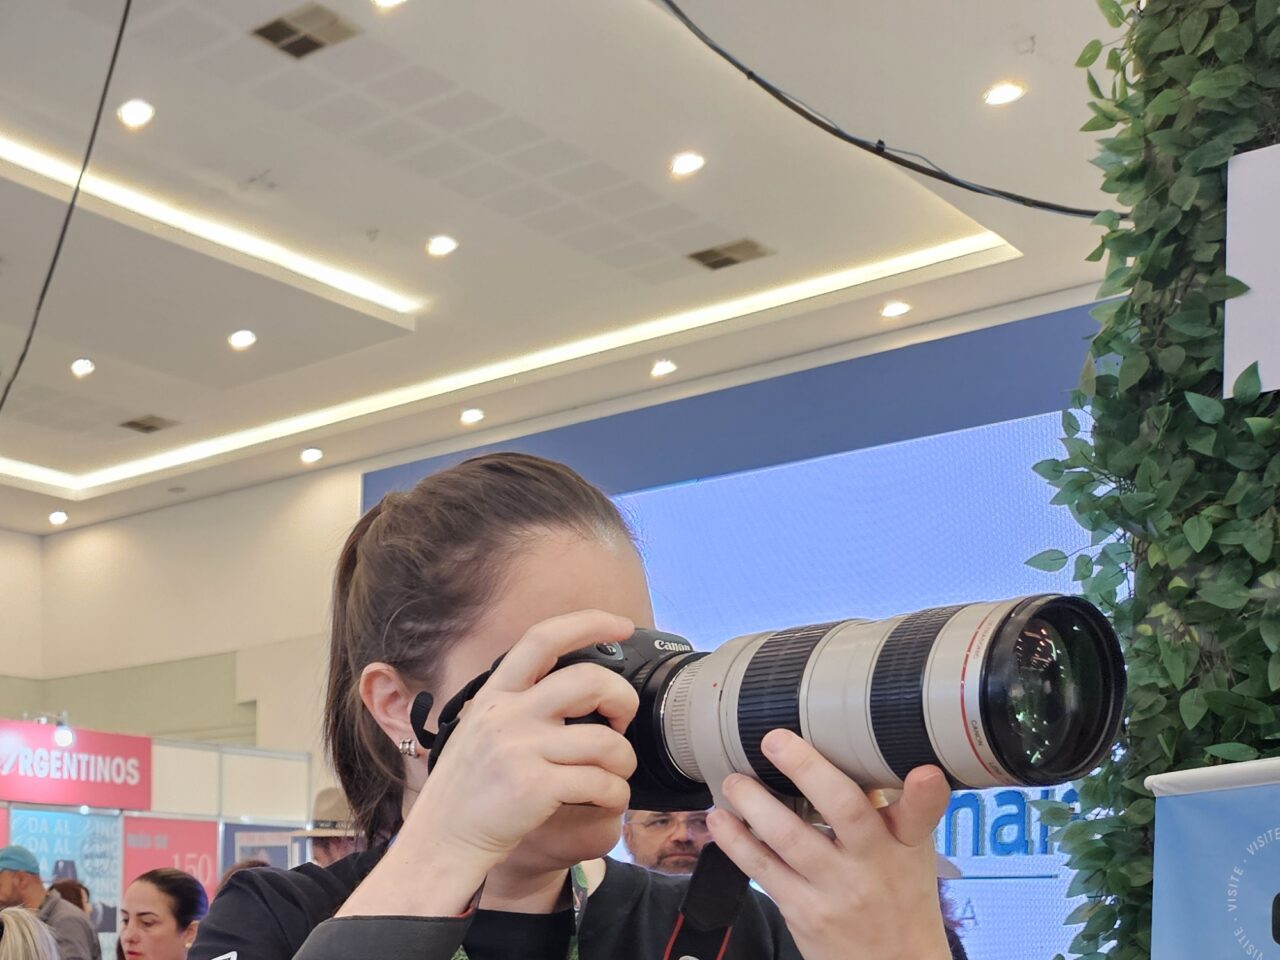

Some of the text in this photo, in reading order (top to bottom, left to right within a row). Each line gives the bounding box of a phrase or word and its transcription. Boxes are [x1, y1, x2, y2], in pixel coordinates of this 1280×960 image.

[654, 639, 691, 651] Canon
[971, 719, 983, 747] CANON
[1246, 827, 1280, 857] VISITE
[1227, 865, 1245, 913] VISITE
